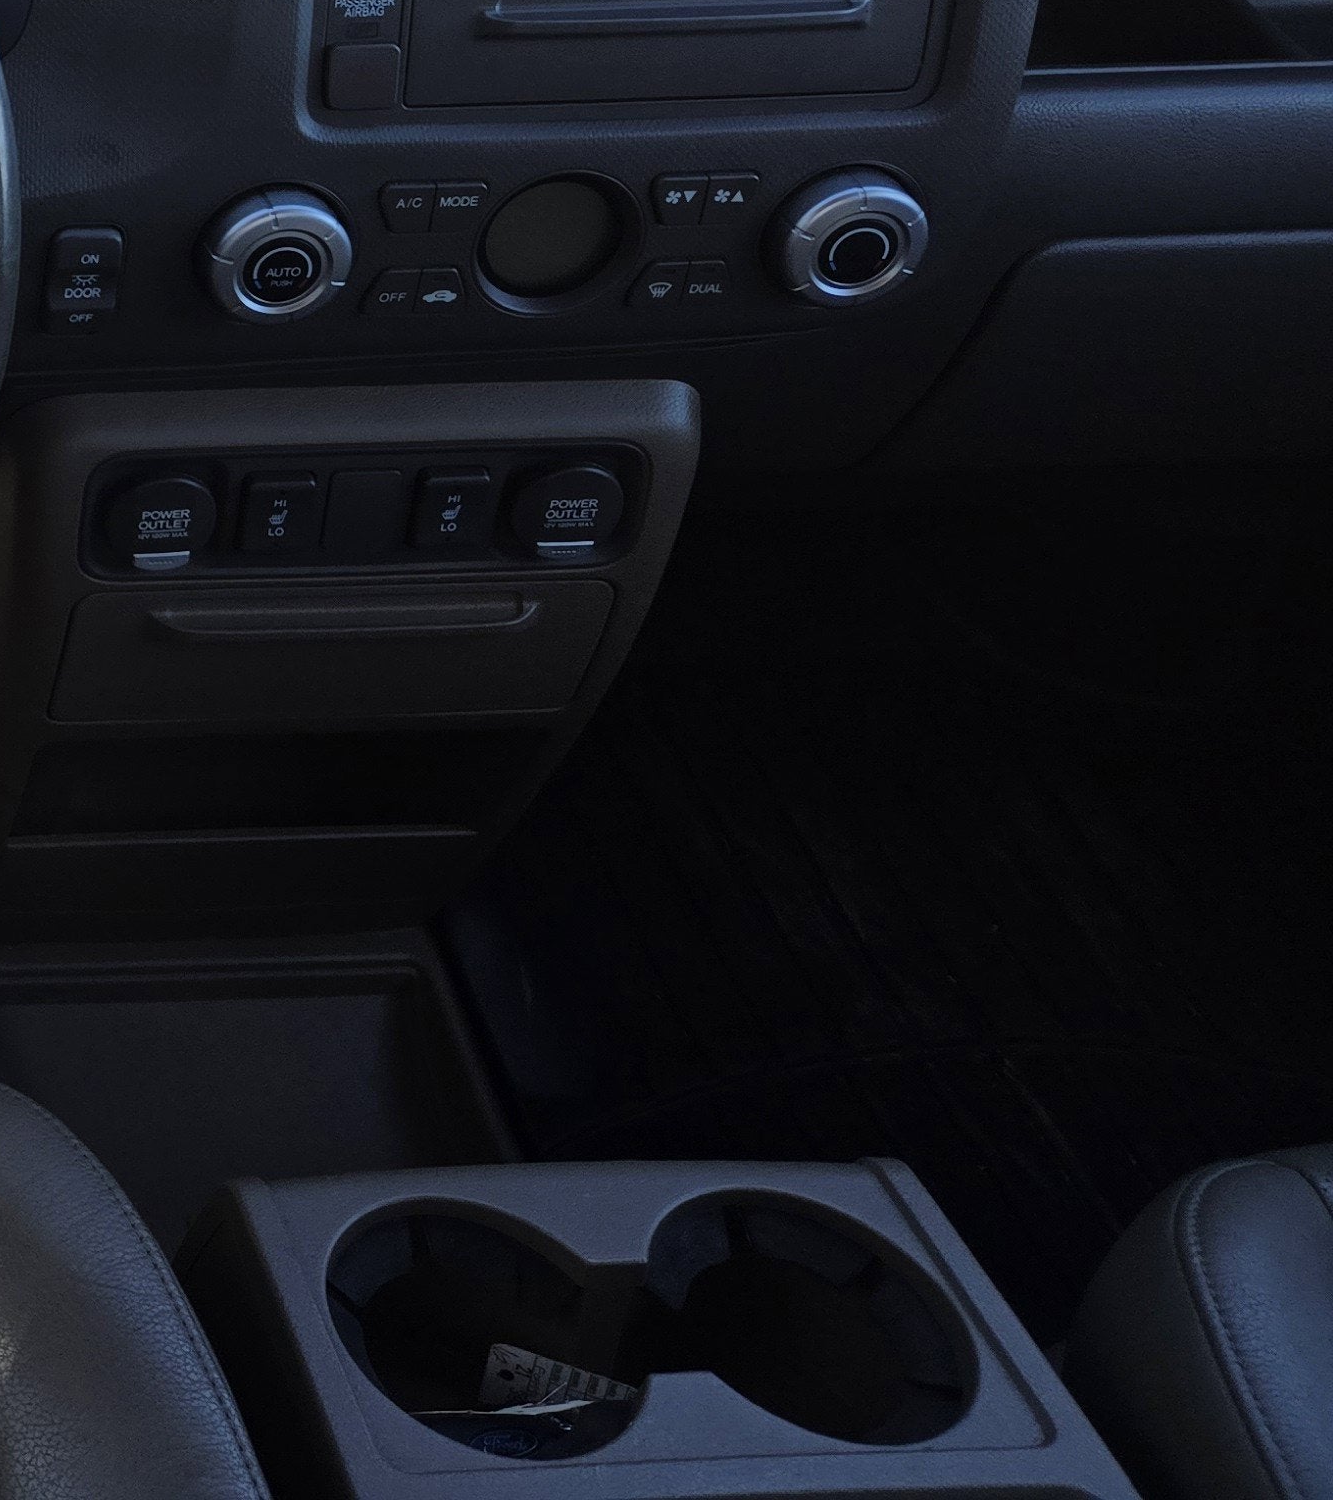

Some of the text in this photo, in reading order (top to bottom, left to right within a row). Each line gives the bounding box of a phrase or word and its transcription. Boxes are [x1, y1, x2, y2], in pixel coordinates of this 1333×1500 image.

[344, 6, 385, 18] AIRBAG
[396, 196, 422, 208] A/C
[439, 196, 479, 208] MODE
[80, 254, 100, 265] ON
[266, 267, 301, 278] AUTO
[64, 287, 101, 298] DOOR
[688, 283, 723, 295] DUAL
[379, 292, 406, 302] OFF
[68, 313, 93, 323] OFF
[448, 495, 461, 503] HI
[550, 499, 598, 509] POWER
[142, 509, 191, 520] POWER
[545, 509, 598, 520] OUTLET
[138, 519, 191, 530] OUTLET
[440, 523, 457, 532] LO
[268, 528, 284, 536] LO
